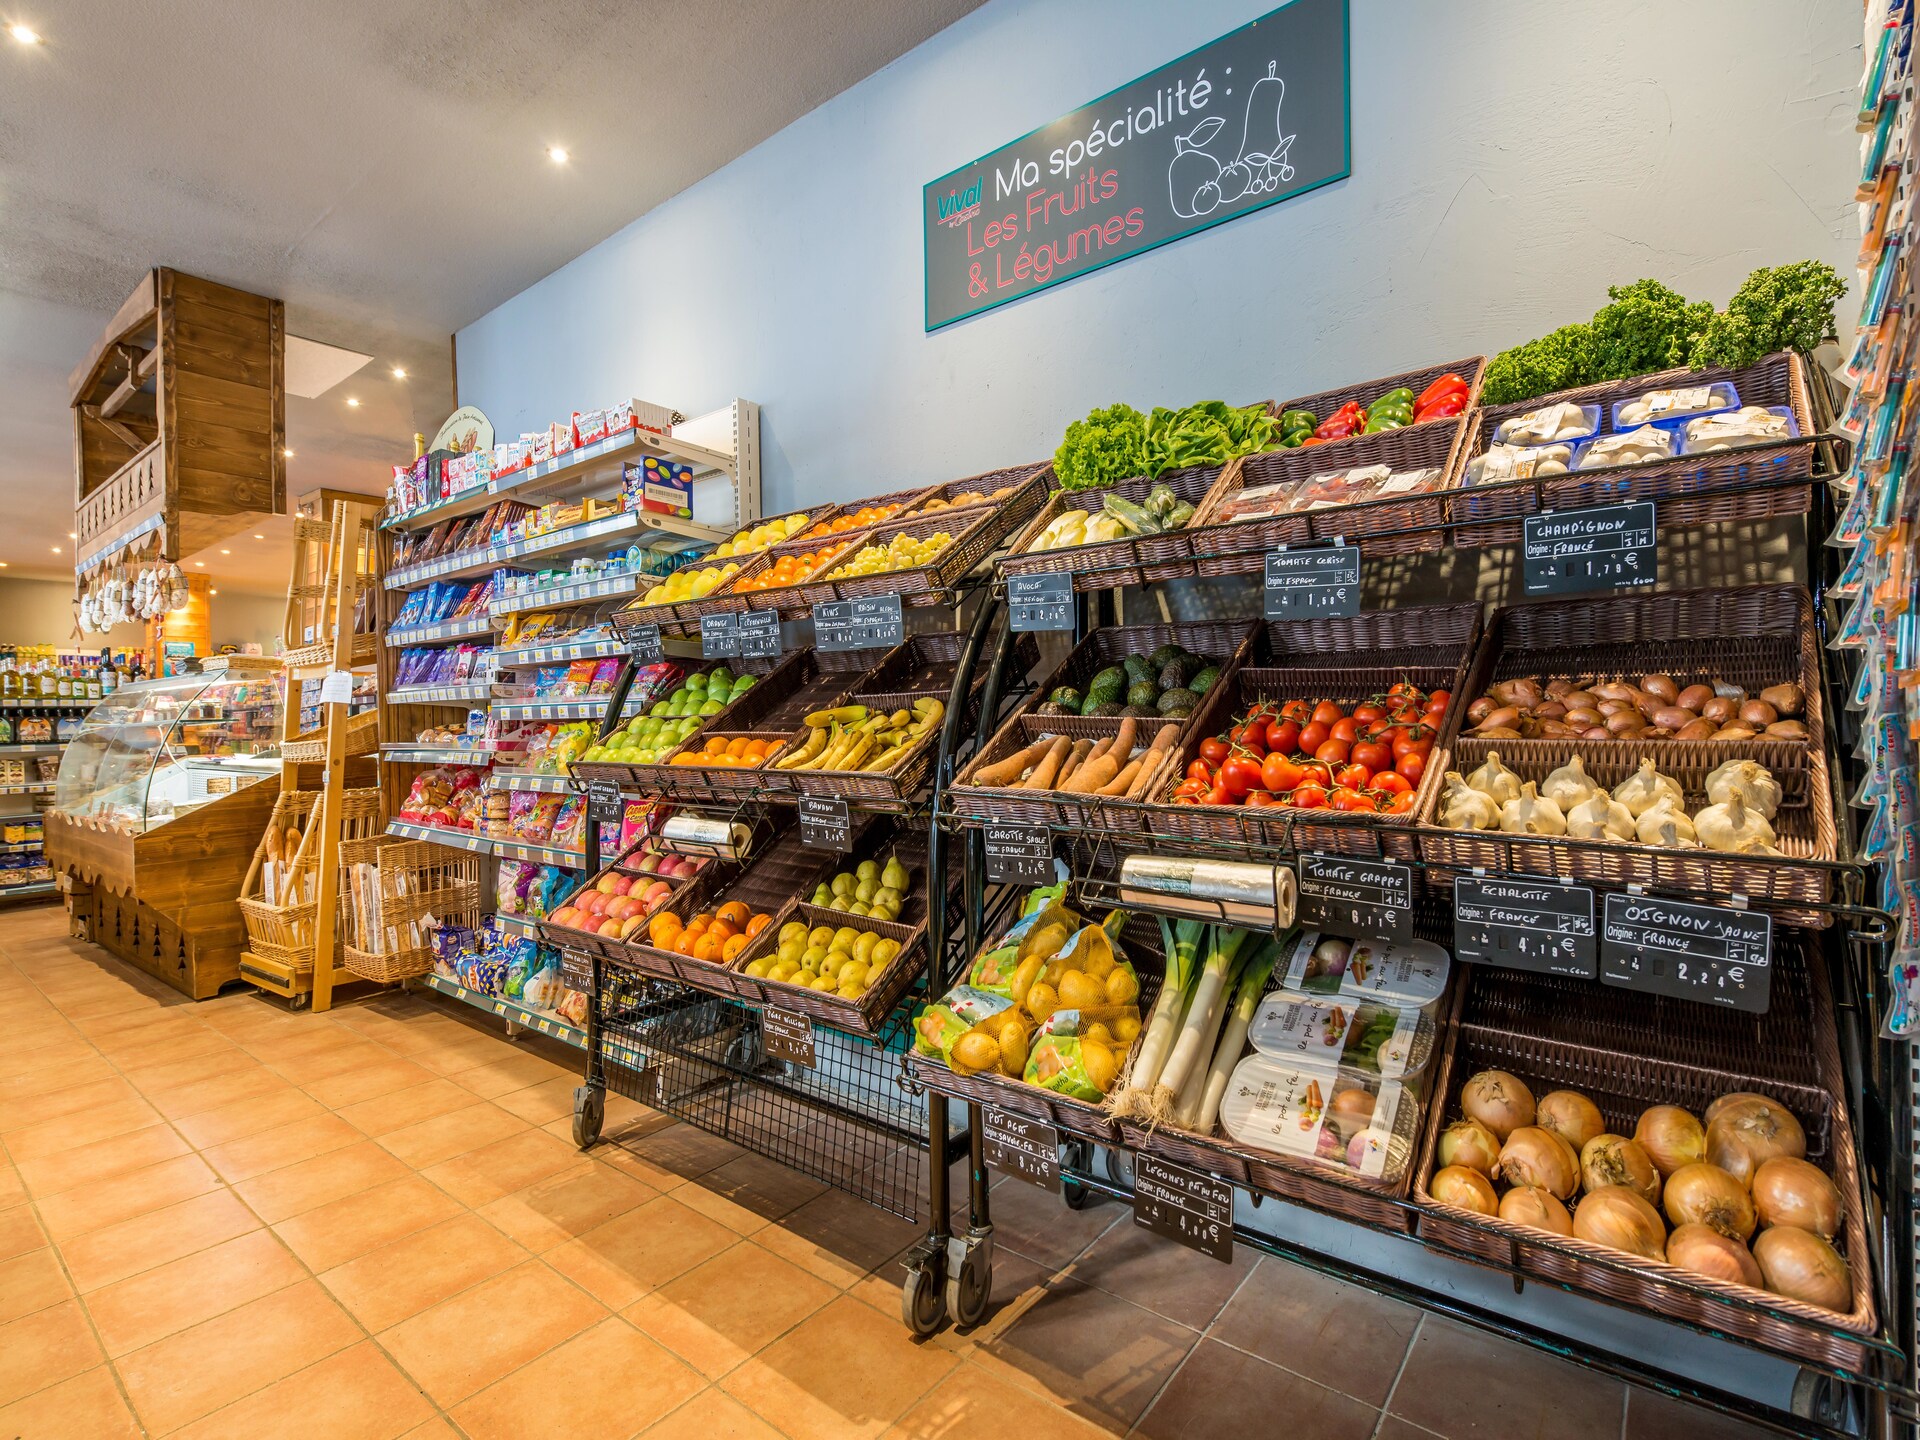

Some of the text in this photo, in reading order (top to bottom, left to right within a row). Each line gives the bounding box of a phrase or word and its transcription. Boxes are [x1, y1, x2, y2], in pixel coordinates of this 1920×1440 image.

[995, 158, 1039, 202] Ma
[1049, 69, 1212, 179] spécialité
[937, 176, 983, 220] Vival
[967, 167, 1119, 257] Les Fruits
[968, 207, 1145, 298] & Légumes
[1308, 862, 1403, 887] TOMATE GRAPPE
[1303, 1024, 1313, 1038] pot
[1278, 1104, 1288, 1120] pot
